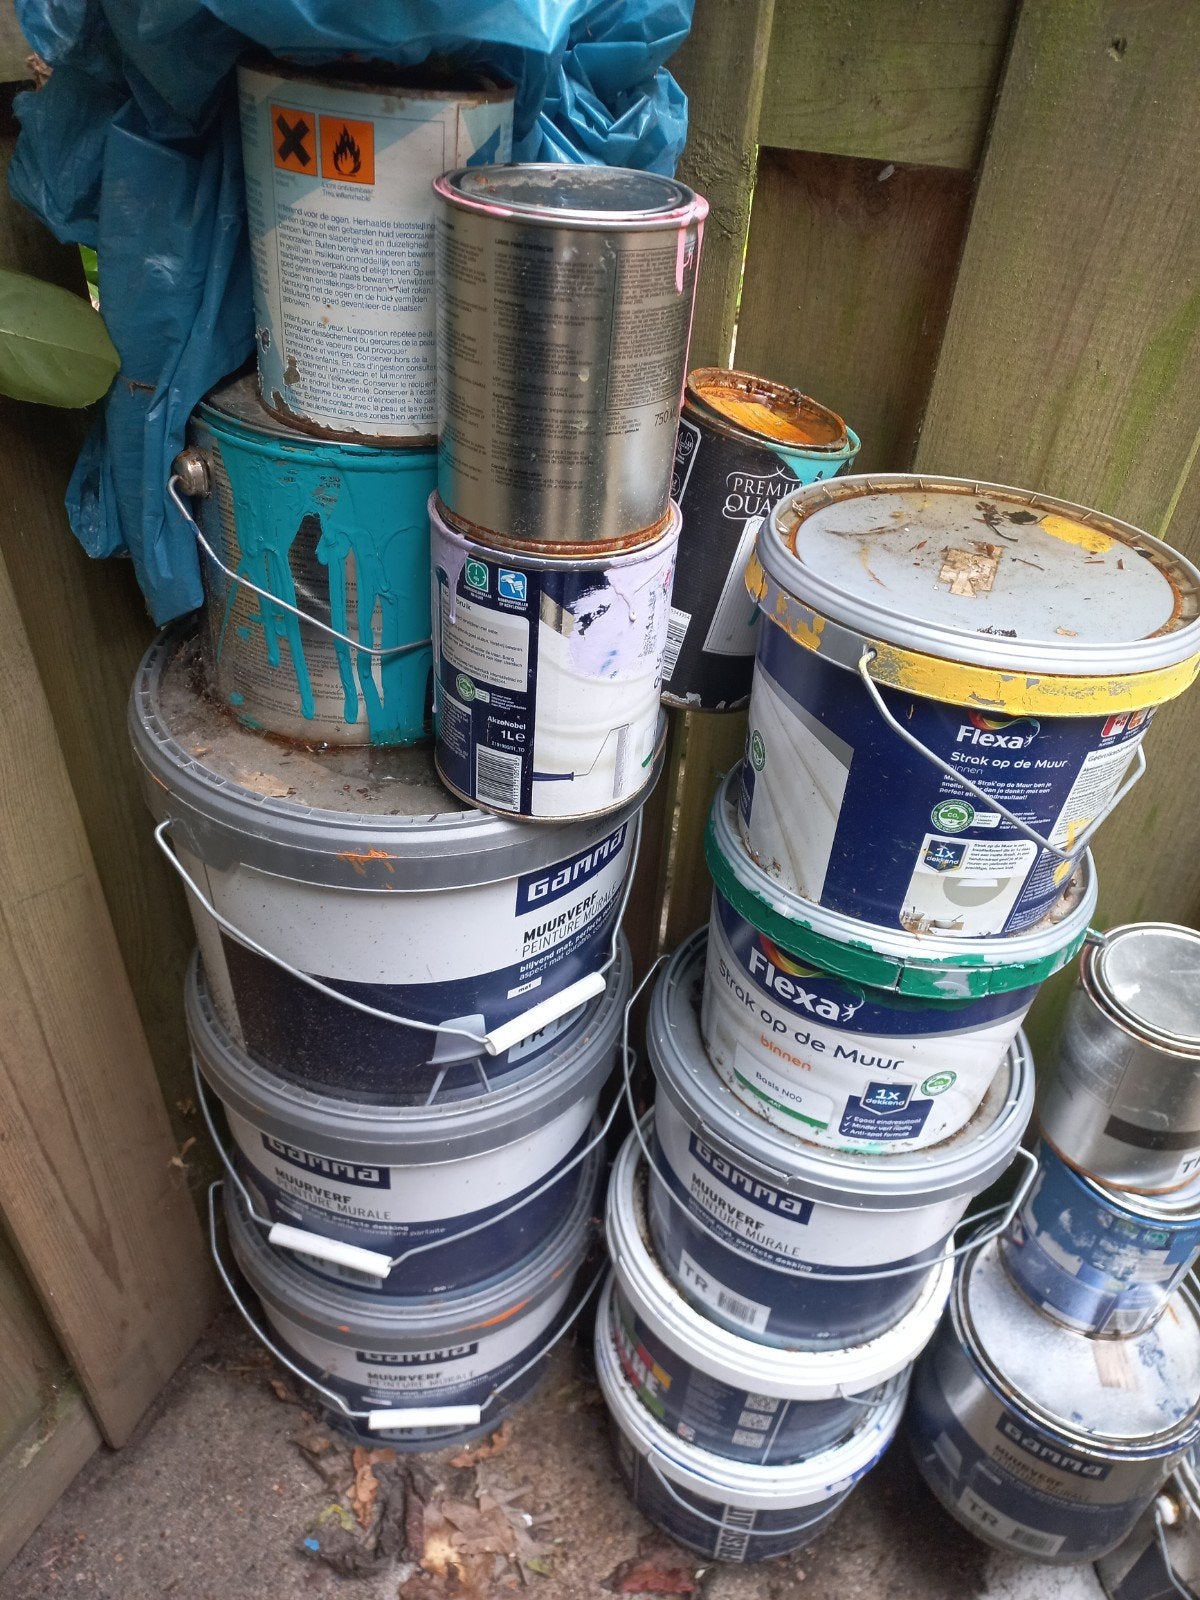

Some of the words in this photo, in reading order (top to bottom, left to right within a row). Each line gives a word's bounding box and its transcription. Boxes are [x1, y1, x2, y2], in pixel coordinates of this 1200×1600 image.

[304, 210, 318, 219] voor
[320, 212, 329, 220] de
[353, 216, 391, 228] Herhaalde
[303, 228, 327, 239] kunnen
[329, 235, 372, 246] slaperigheid
[341, 227, 376, 237] gebarsten
[378, 229, 394, 238] huid
[315, 240, 336, 250] Buiten
[375, 248, 406, 258] kinderen
[315, 250, 344, 260] inslikken
[346, 256, 389, 267] onmiddellijk
[322, 262, 359, 274] verpakking
[339, 272, 360, 281] plaats
[362, 275, 395, 284] bewaren.
[322, 297, 339, 305] goed
[335, 290, 352, 298] ogen
[376, 294, 393, 302] huid
[317, 321, 326, 329] les
[347, 326, 388, 337] L'exposition
[418, 330, 433, 338] peut
[326, 342, 352, 350] vapeurs
[372, 347, 407, 355] provoquer
[357, 353, 392, 362] Conserver
[367, 363, 404, 372] d'ingestion
[309, 379, 330, 388] endroit
[373, 387, 408, 396] Conserver
[363, 378, 398, 388] Conserver
[329, 399, 352, 408] contact
[342, 394, 366, 402] source
[654, 410, 669, 427] 750
[733, 478, 802, 497] PREMIU
[487, 715, 526, 730] AkzoNobel
[956, 725, 1026, 749] Flexa
[950, 751, 989, 766] Strak
[992, 758, 1011, 769] op
[1015, 757, 1032, 769] de
[1034, 759, 1068, 770] Muur
[935, 848, 956, 859] 1x
[523, 889, 599, 943] MUURVERF
[522, 917, 581, 958] PEINTURE
[519, 963, 549, 981] aspect
[550, 955, 564, 965] mat
[520, 950, 555, 973] blijvend
[518, 984, 532, 993] mat
[749, 946, 841, 1021] Flexa
[717, 958, 756, 1013] Strak
[760, 1010, 788, 1038] op
[795, 1030, 826, 1053] de
[833, 1045, 904, 1070] Muur
[761, 1034, 812, 1072] binnen
[755, 1071, 780, 1092] Basis
[866, 1097, 905, 1107] dekkend
[875, 1088, 901, 1101] 1x
[851, 1122, 877, 1131] Minder
[878, 1124, 894, 1132] verf
[895, 1124, 912, 1132] nodig
[853, 1116, 875, 1124] Egaal
[275, 1167, 352, 1203] MUURVERF
[277, 1178, 332, 1209] PEINTURE
[338, 1205, 391, 1220] MURALE
[692, 1173, 765, 1230] MUURVERF
[372, 1224, 409, 1232] dekking
[690, 1184, 743, 1232] PEINTURE
[746, 1228, 801, 1257] MURALE
[410, 1228, 446, 1237] parfaite
[736, 1238, 774, 1260] perfecte
[775, 1256, 813, 1272] dekking
[684, 1262, 709, 1293] TR
[367, 1371, 442, 1382] MUURVERF
[994, 1444, 1064, 1488] MUURVERF
[970, 1501, 999, 1526] TR
